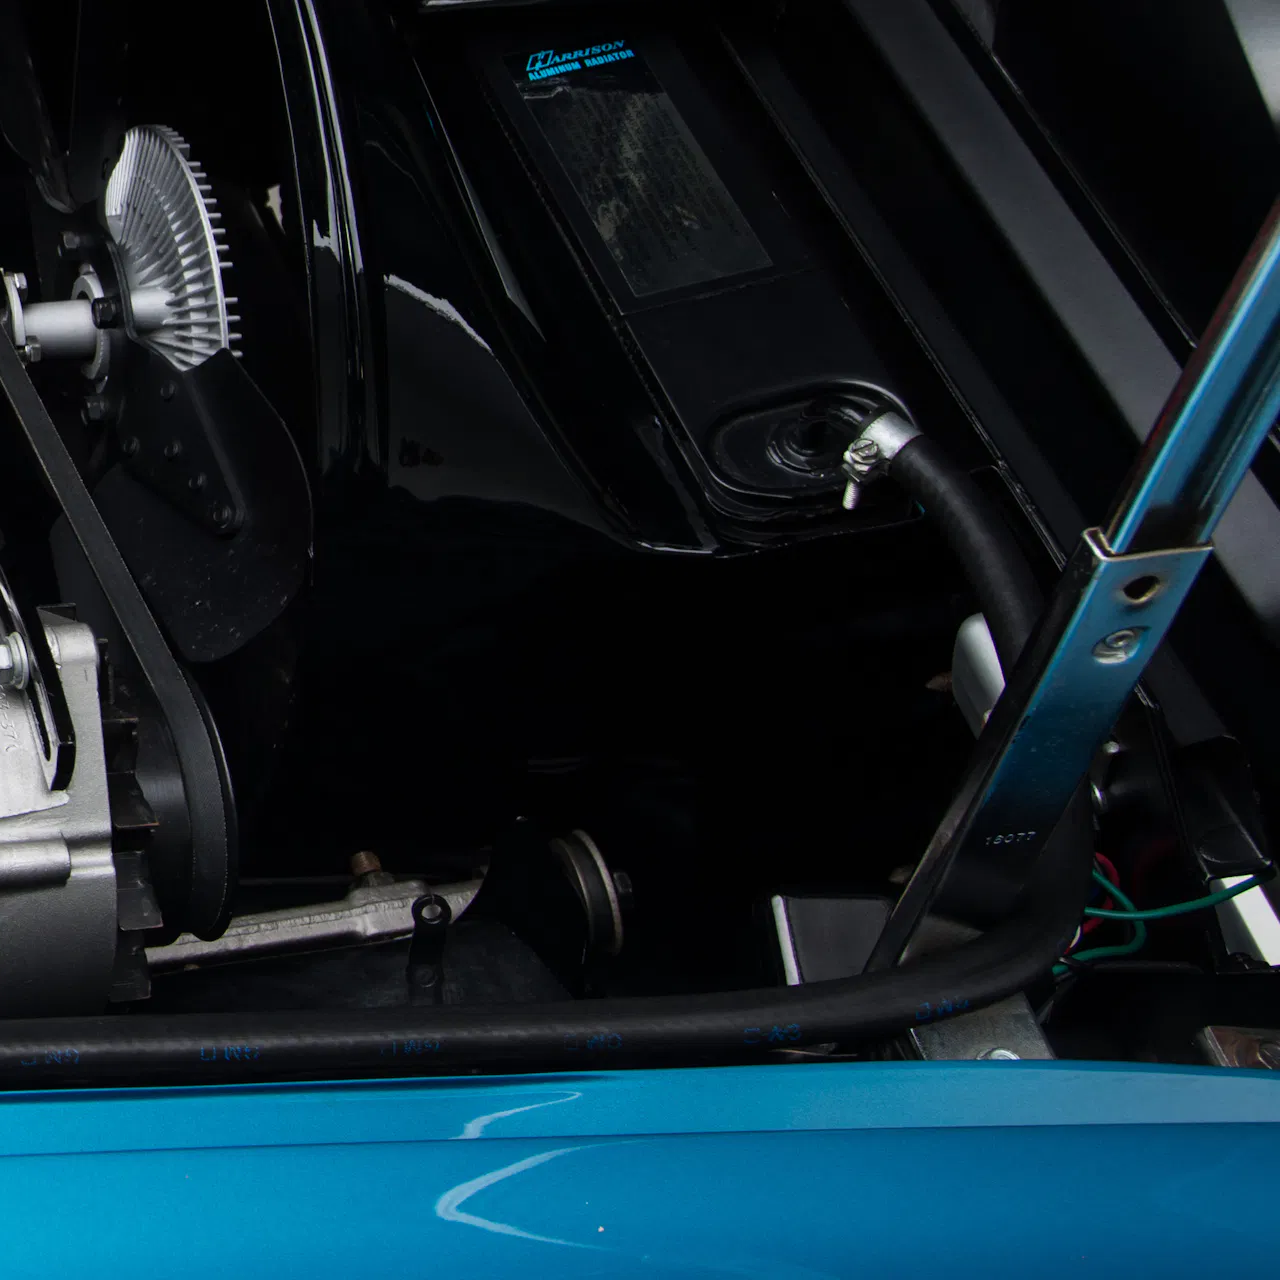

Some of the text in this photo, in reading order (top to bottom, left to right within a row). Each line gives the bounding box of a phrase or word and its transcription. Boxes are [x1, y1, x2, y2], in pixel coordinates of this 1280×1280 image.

[526, 40, 625, 71] HARRISON
[528, 49, 635, 81] ALUMINUM RADIATOR
